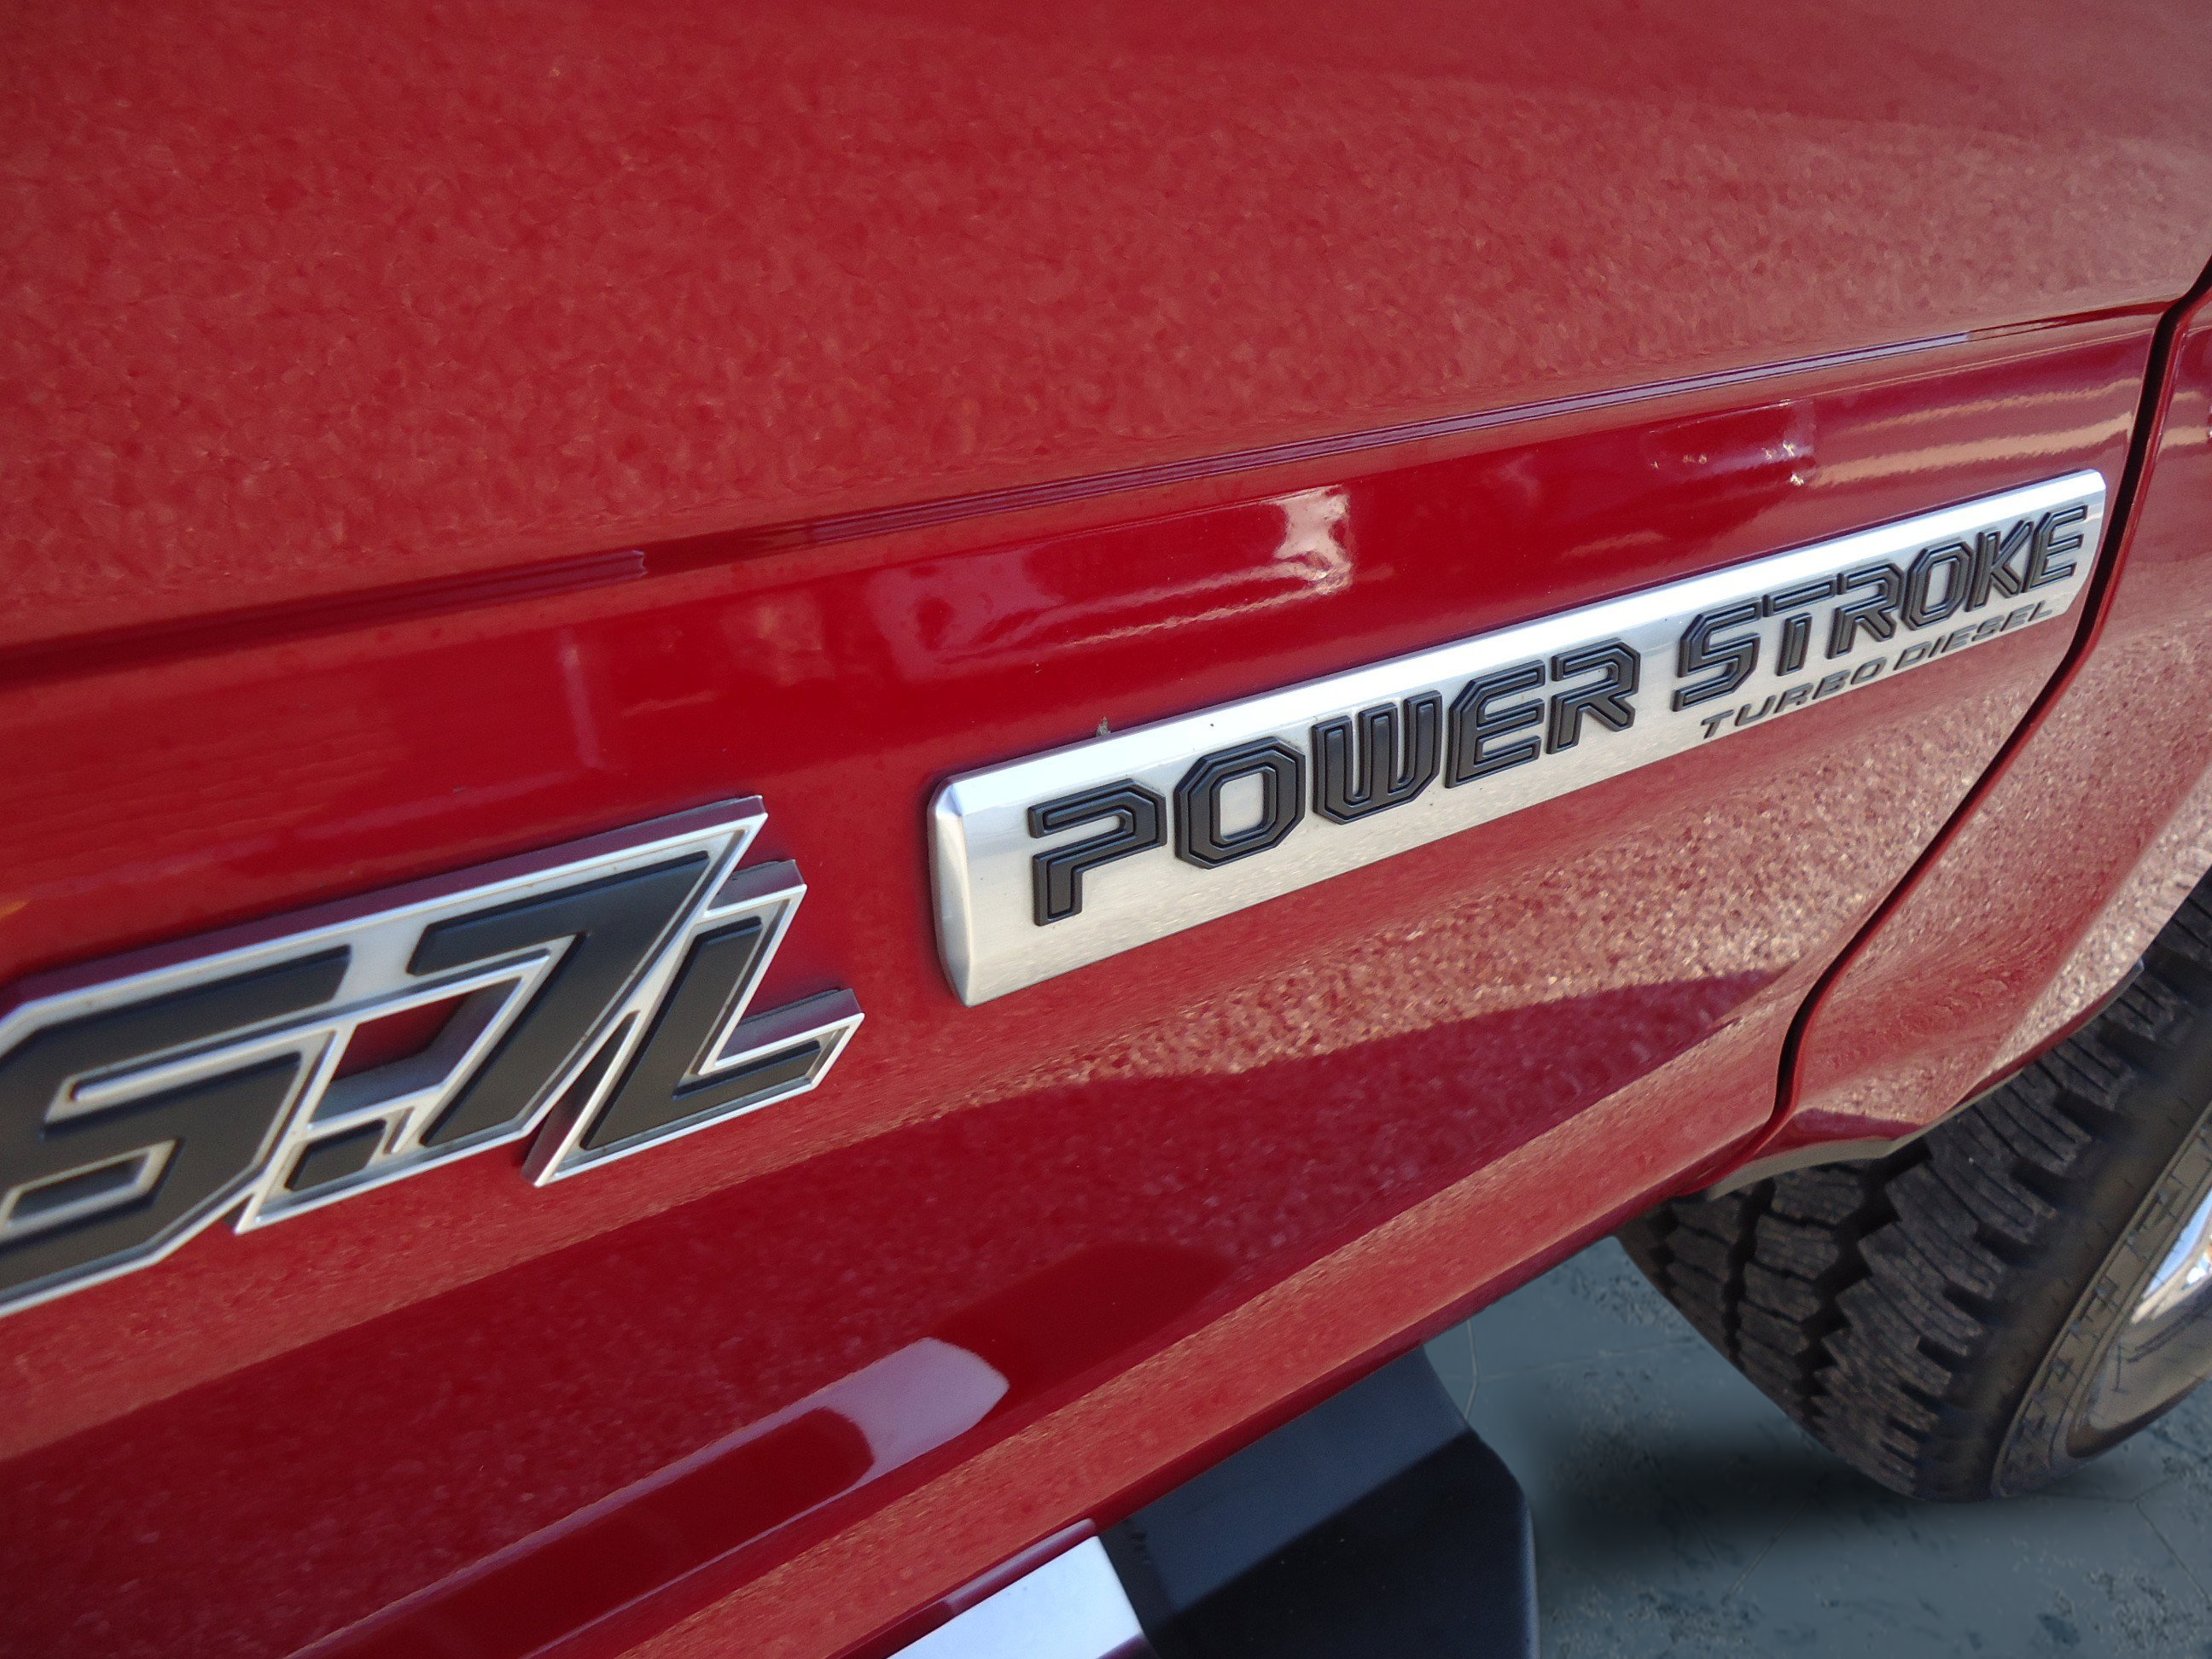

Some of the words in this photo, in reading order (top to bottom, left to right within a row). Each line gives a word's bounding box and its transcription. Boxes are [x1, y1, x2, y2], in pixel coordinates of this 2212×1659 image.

[1027, 637, 1641, 927] POWER
[1670, 504, 2089, 713] STROKE
[1701, 656, 1888, 740] TURBO
[1894, 599, 2053, 671] DIESEL
[0, 805, 864, 1316] 6.7L
